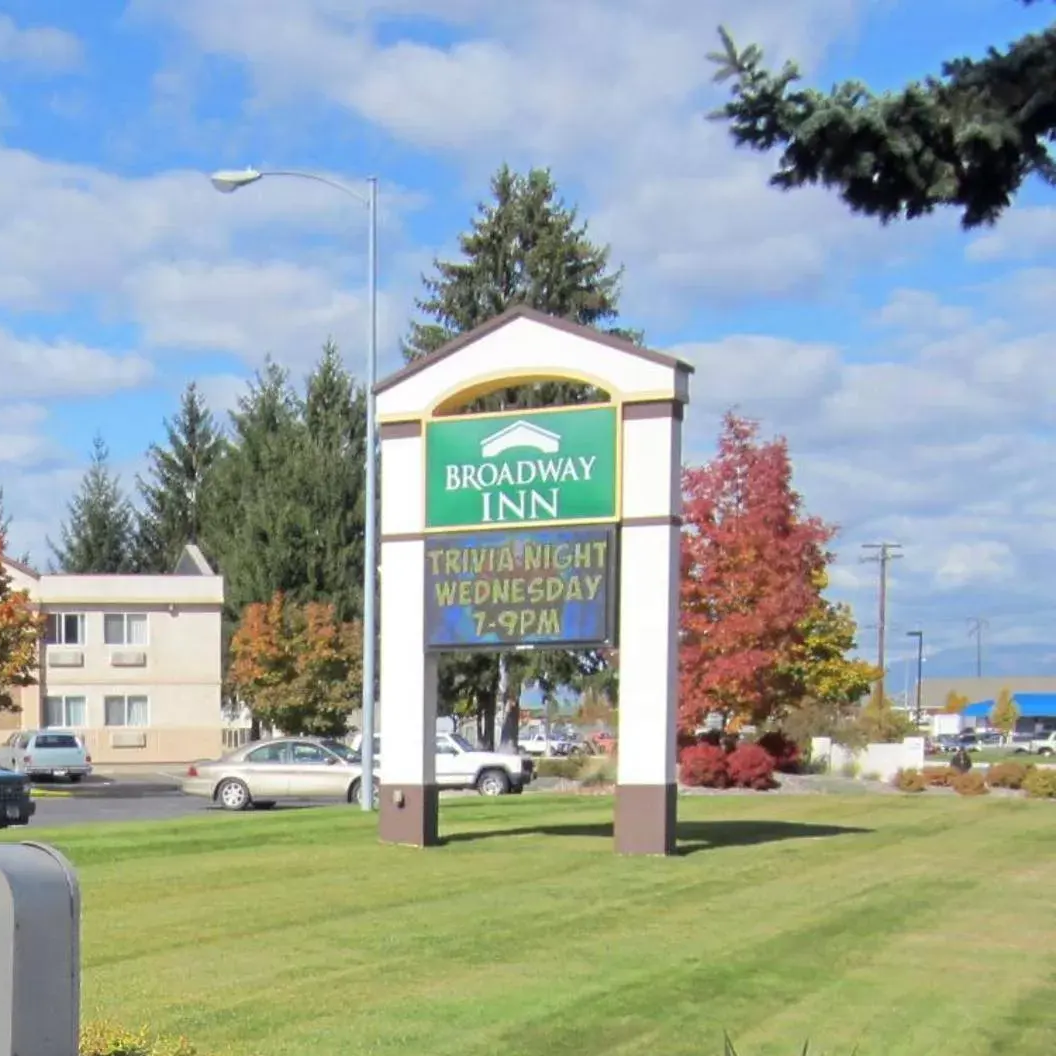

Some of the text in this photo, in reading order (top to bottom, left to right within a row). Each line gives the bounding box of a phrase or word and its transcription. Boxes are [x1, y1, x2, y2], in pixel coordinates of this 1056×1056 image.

[445, 456, 596, 490] BROADWAY
[482, 489, 559, 522] INN
[429, 542, 607, 575] TRIVIA NIGHT
[435, 575, 601, 606] WEDNESDAY
[473, 609, 560, 636] 7-9PM
